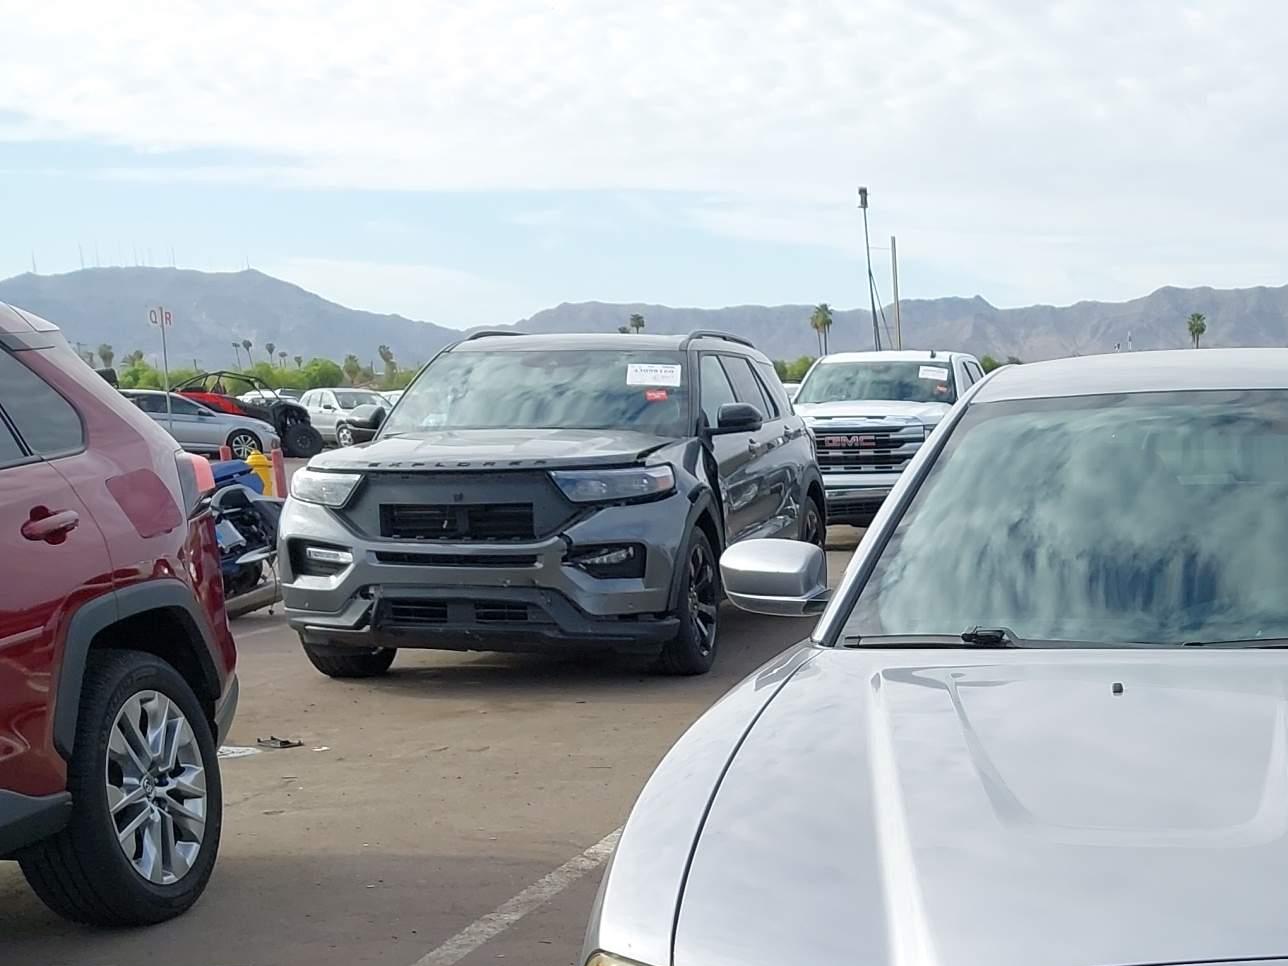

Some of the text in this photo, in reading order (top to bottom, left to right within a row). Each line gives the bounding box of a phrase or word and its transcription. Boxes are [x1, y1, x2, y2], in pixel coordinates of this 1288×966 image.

[149, 309, 158, 324] Q
[164, 311, 172, 326] R
[824, 435, 876, 448] GMC
[367, 460, 548, 468] EXPLORER
